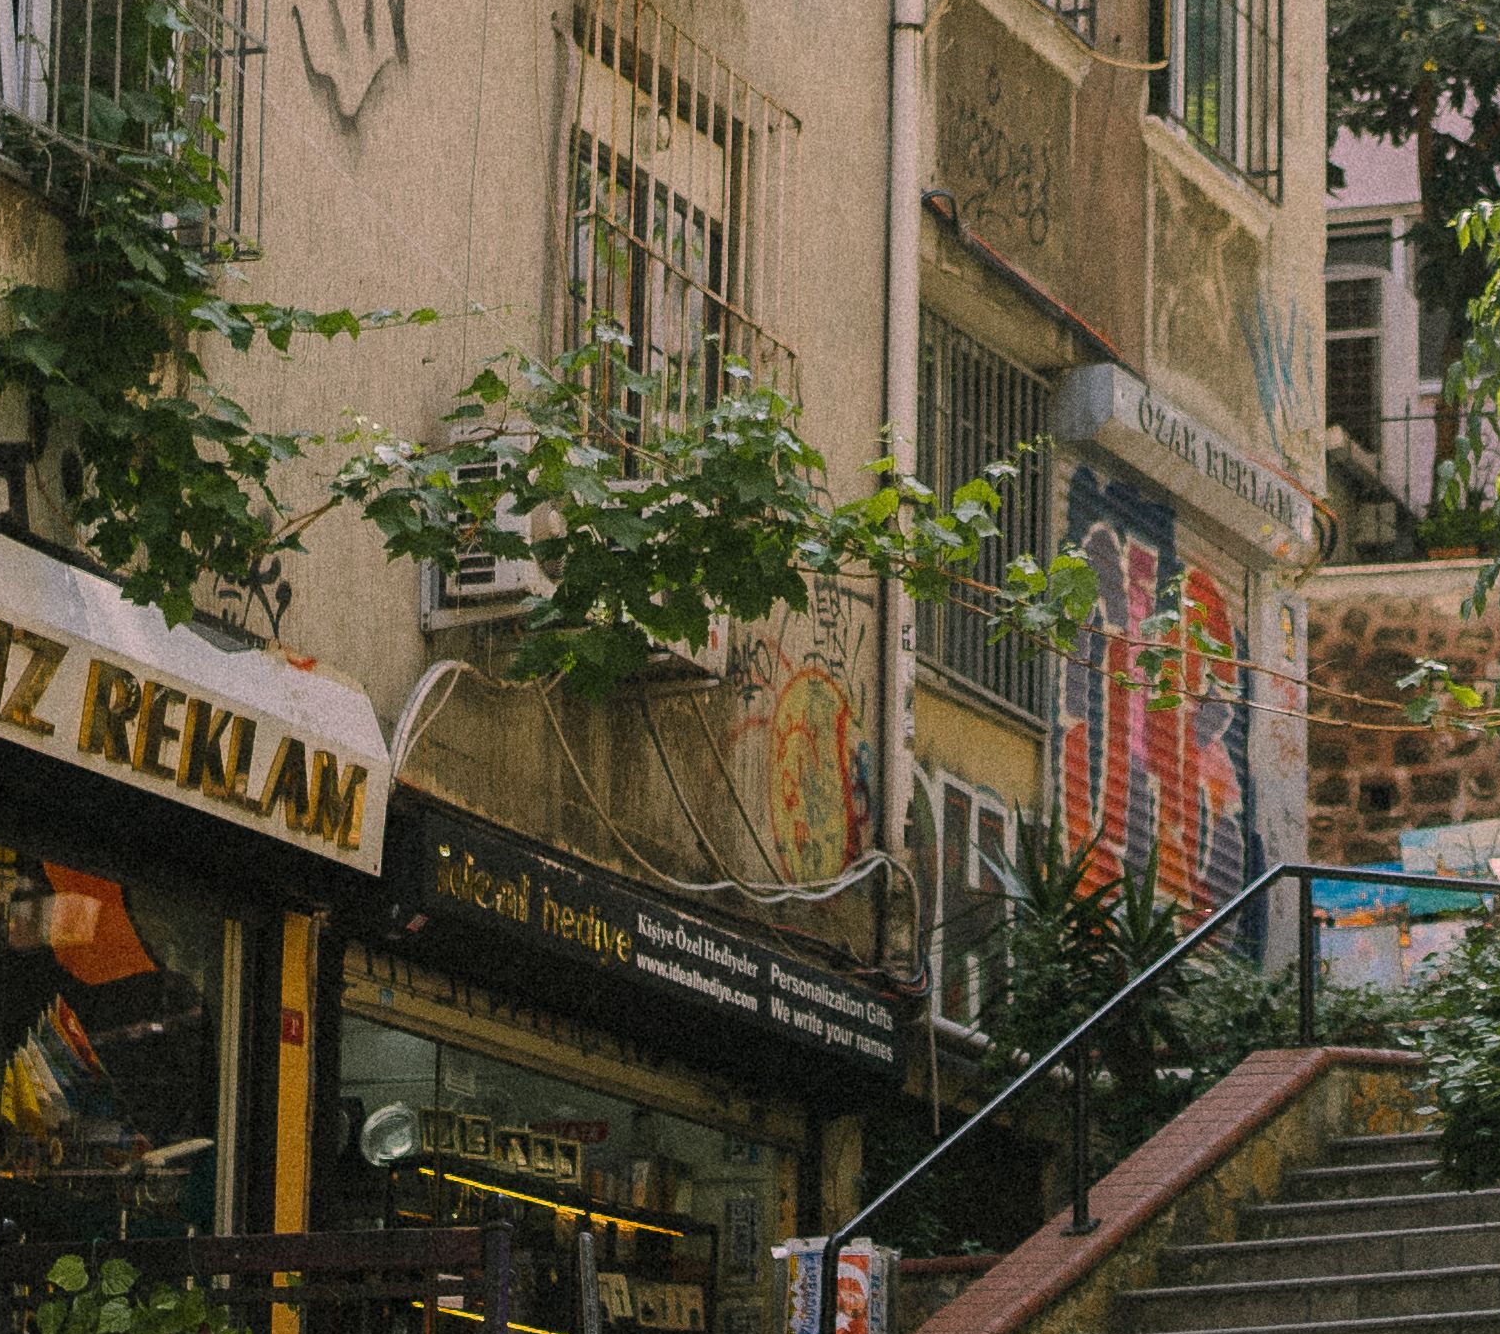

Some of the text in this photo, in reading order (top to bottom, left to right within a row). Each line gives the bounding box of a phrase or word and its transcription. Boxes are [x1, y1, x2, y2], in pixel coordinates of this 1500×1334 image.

[77, 657, 367, 851] REKLAM
[543, 887, 633, 965] hediye
[637, 912, 759, 980] Kişiye Özel Hediyeler
[636, 951, 759, 1013] www.idealhediye.com
[771, 961, 894, 1033] Personalization Gifts
[771, 996, 894, 1064] We write your names
